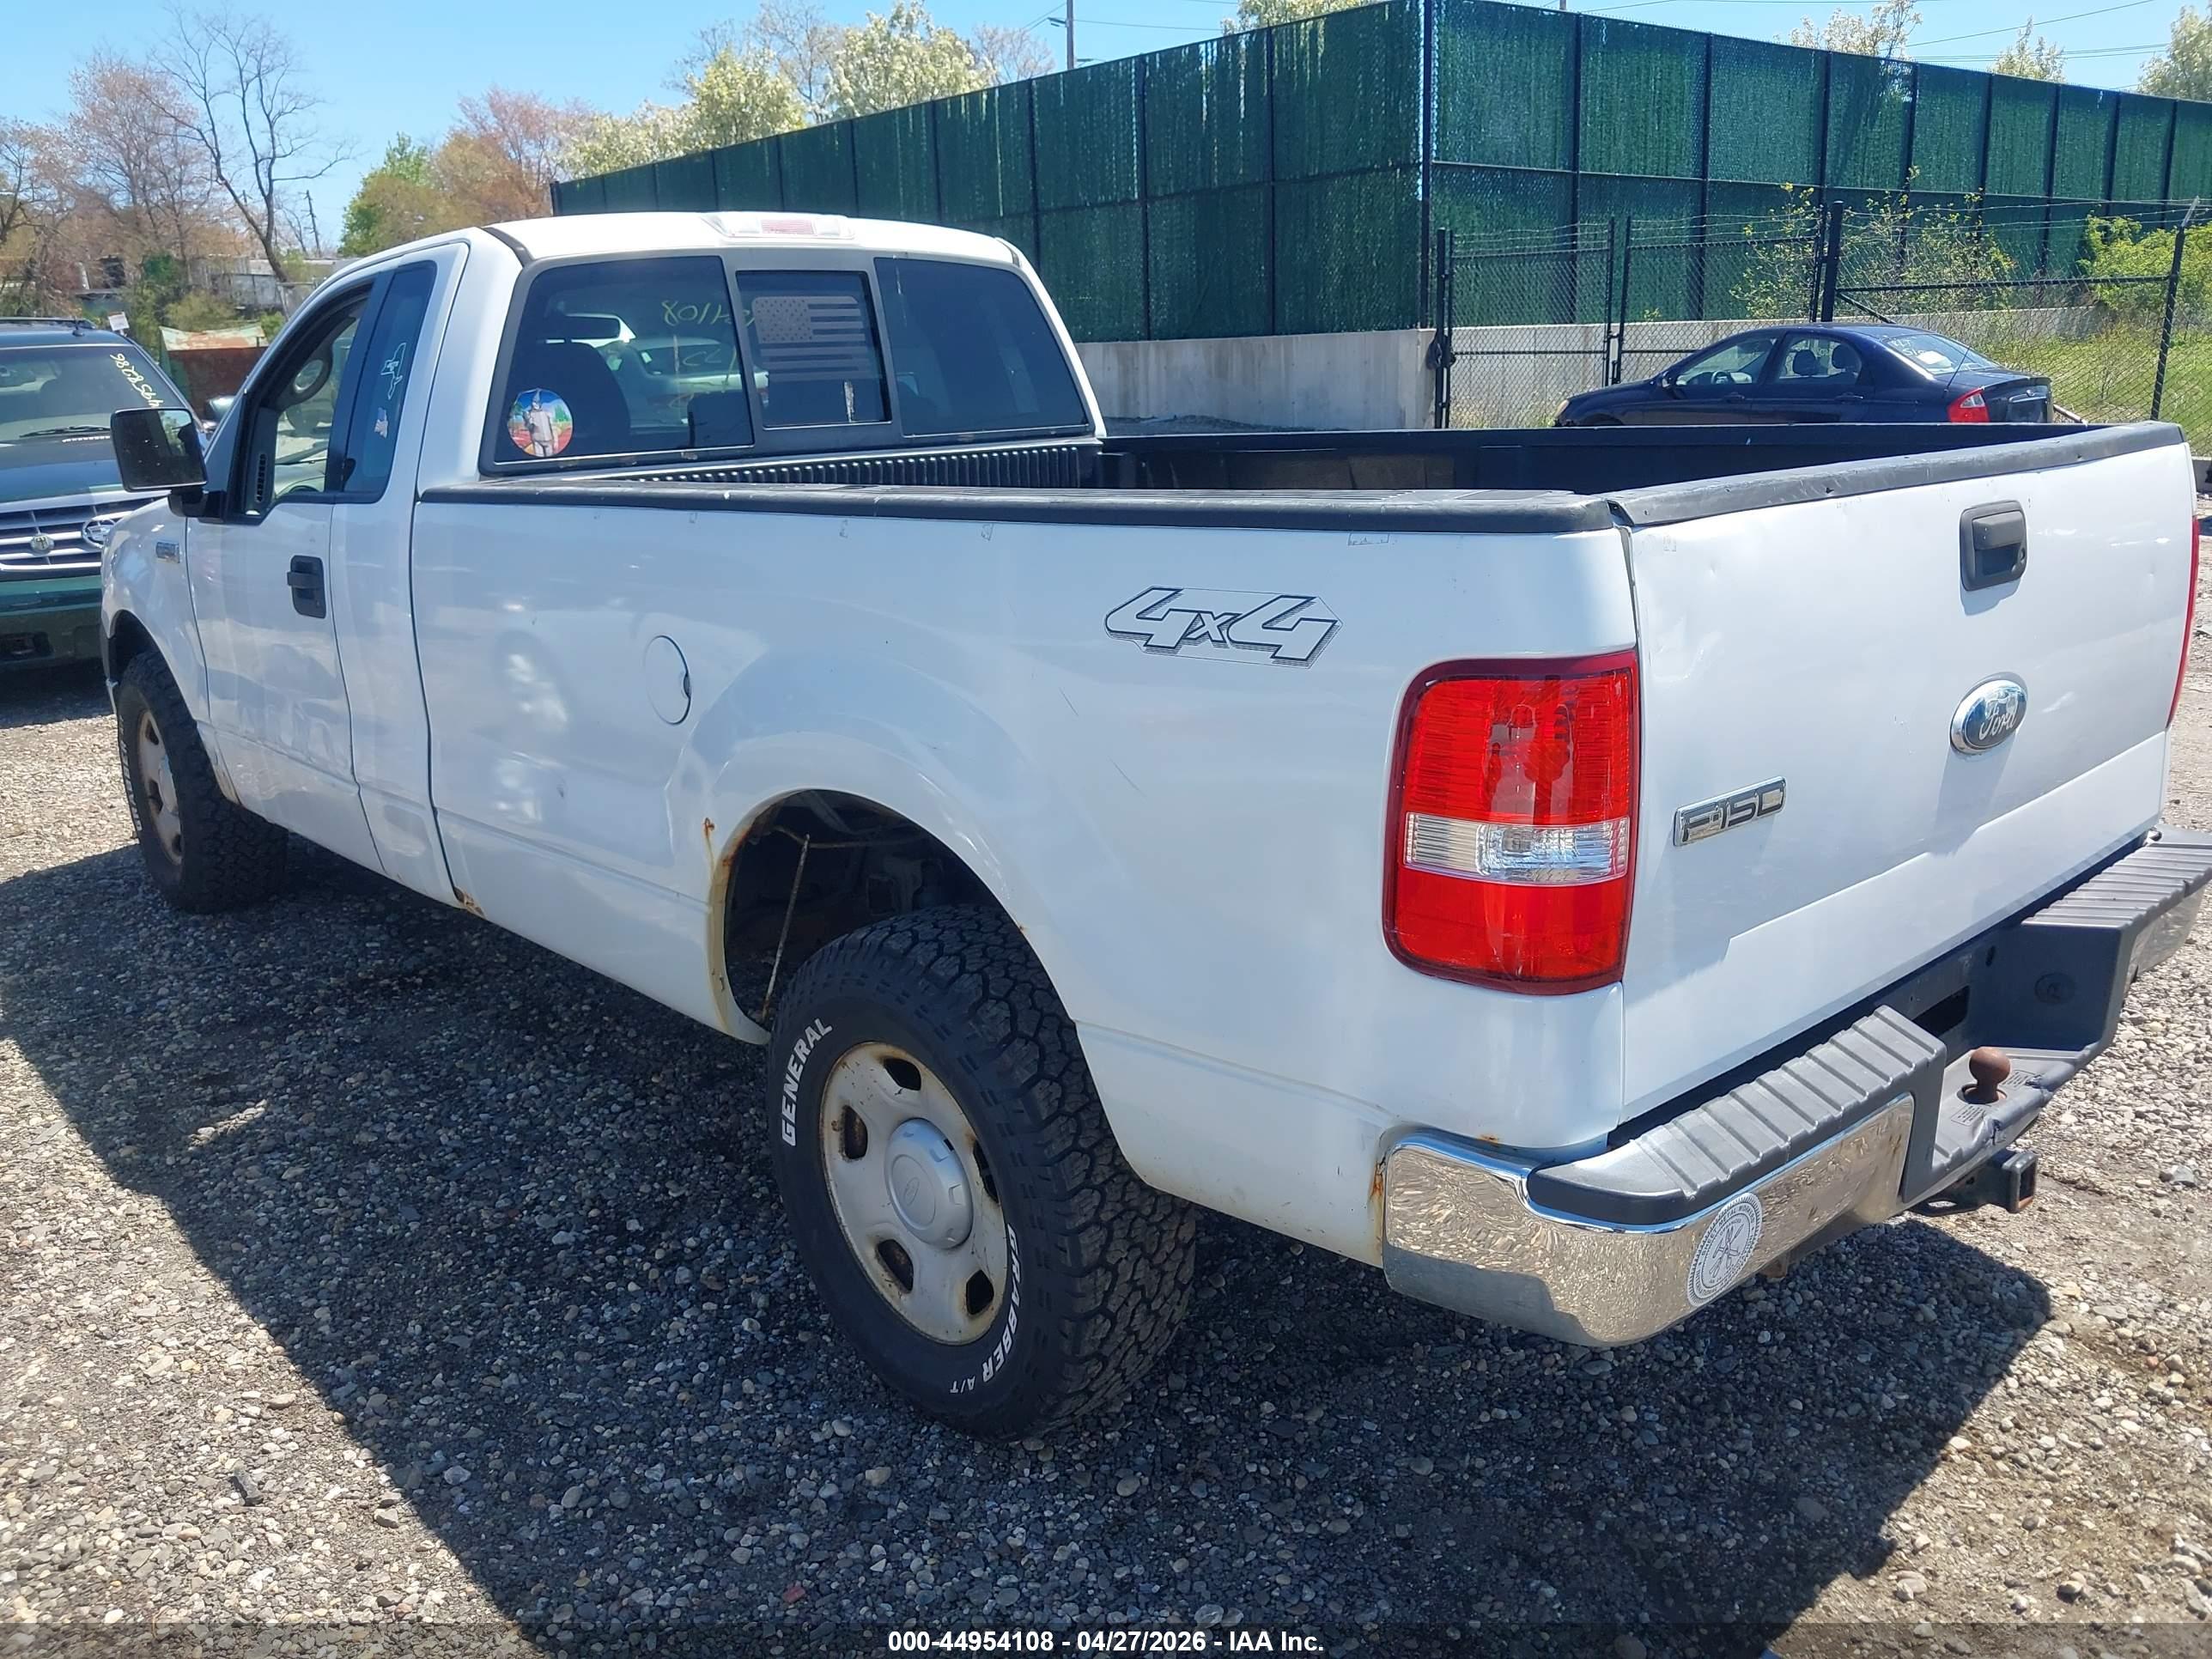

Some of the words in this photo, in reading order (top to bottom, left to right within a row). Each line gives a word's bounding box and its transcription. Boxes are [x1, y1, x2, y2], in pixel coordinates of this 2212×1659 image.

[1978, 696, 2018, 740] Ford
[781, 1018, 833, 1146] GENERAL
[982, 1223, 1022, 1382] GRABBER
[950, 1376, 976, 1394] A/T
